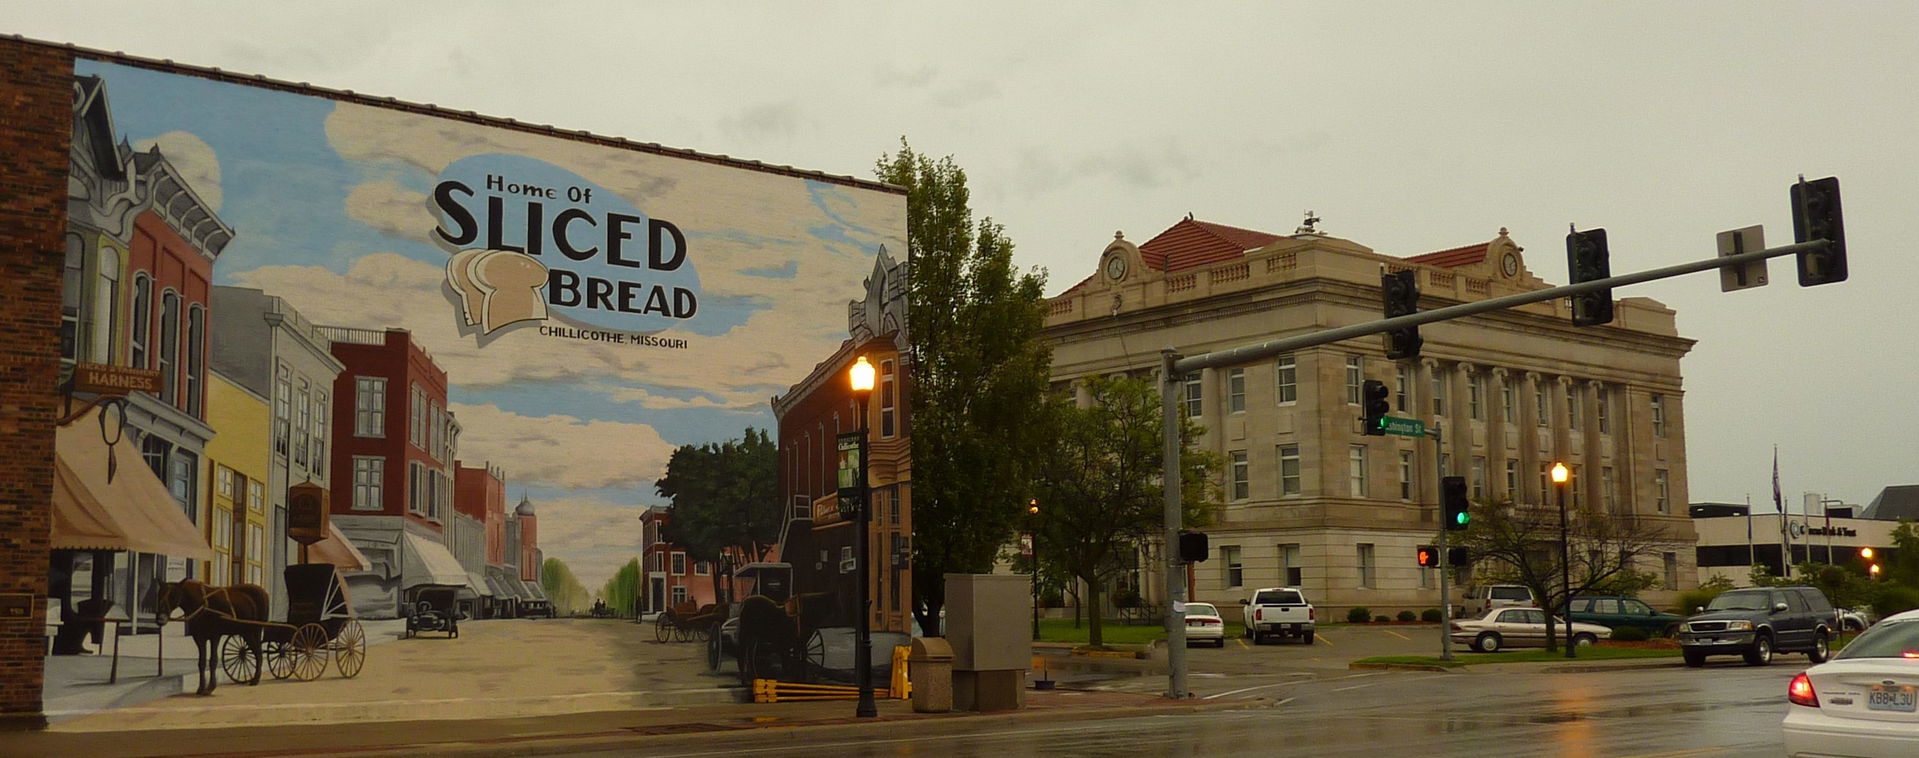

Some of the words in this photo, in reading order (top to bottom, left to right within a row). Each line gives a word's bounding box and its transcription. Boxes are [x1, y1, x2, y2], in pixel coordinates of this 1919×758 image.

[486, 174, 557, 200] Home
[567, 186, 592, 204] Of
[434, 180, 687, 272] SLICED
[549, 268, 698, 319] BREAD
[630, 335, 688, 349] MISSOURI
[88, 372, 153, 390] HARNESS
